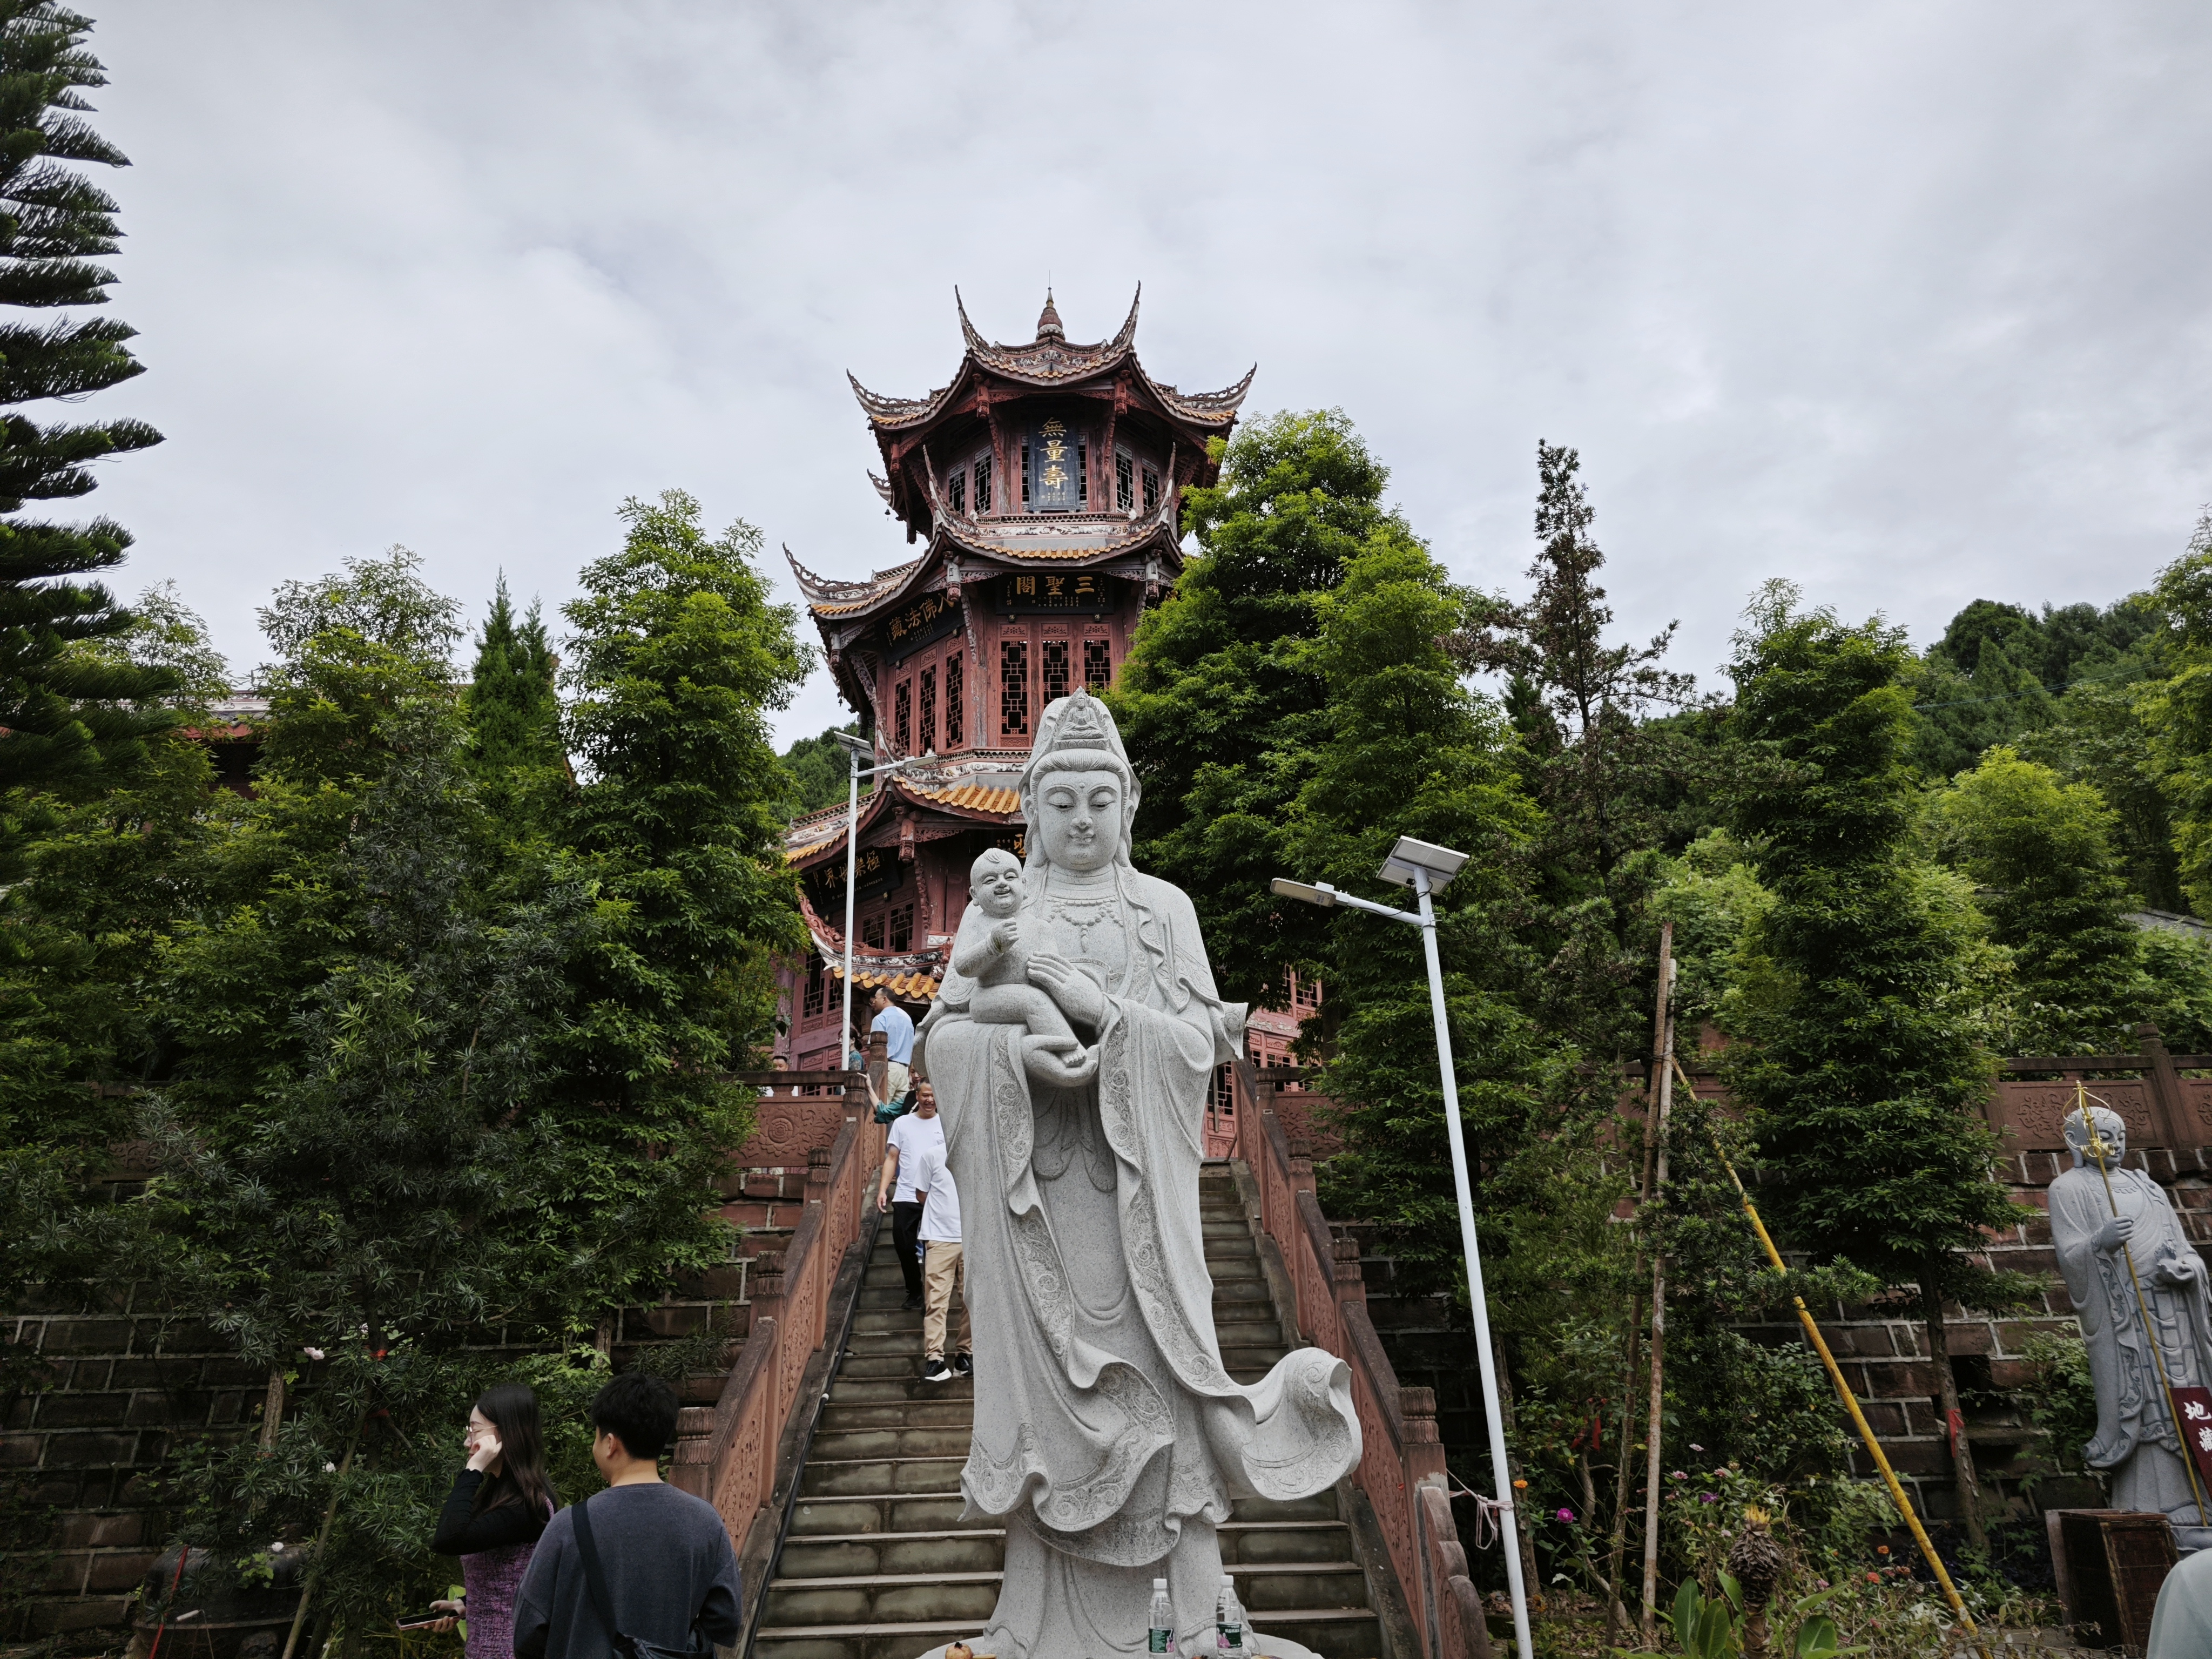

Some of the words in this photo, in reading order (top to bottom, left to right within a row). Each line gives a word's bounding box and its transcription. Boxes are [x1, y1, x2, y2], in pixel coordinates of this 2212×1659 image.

[1038, 417, 1069, 489] 無量壽
[1016, 576, 1095, 596] 三聖閣
